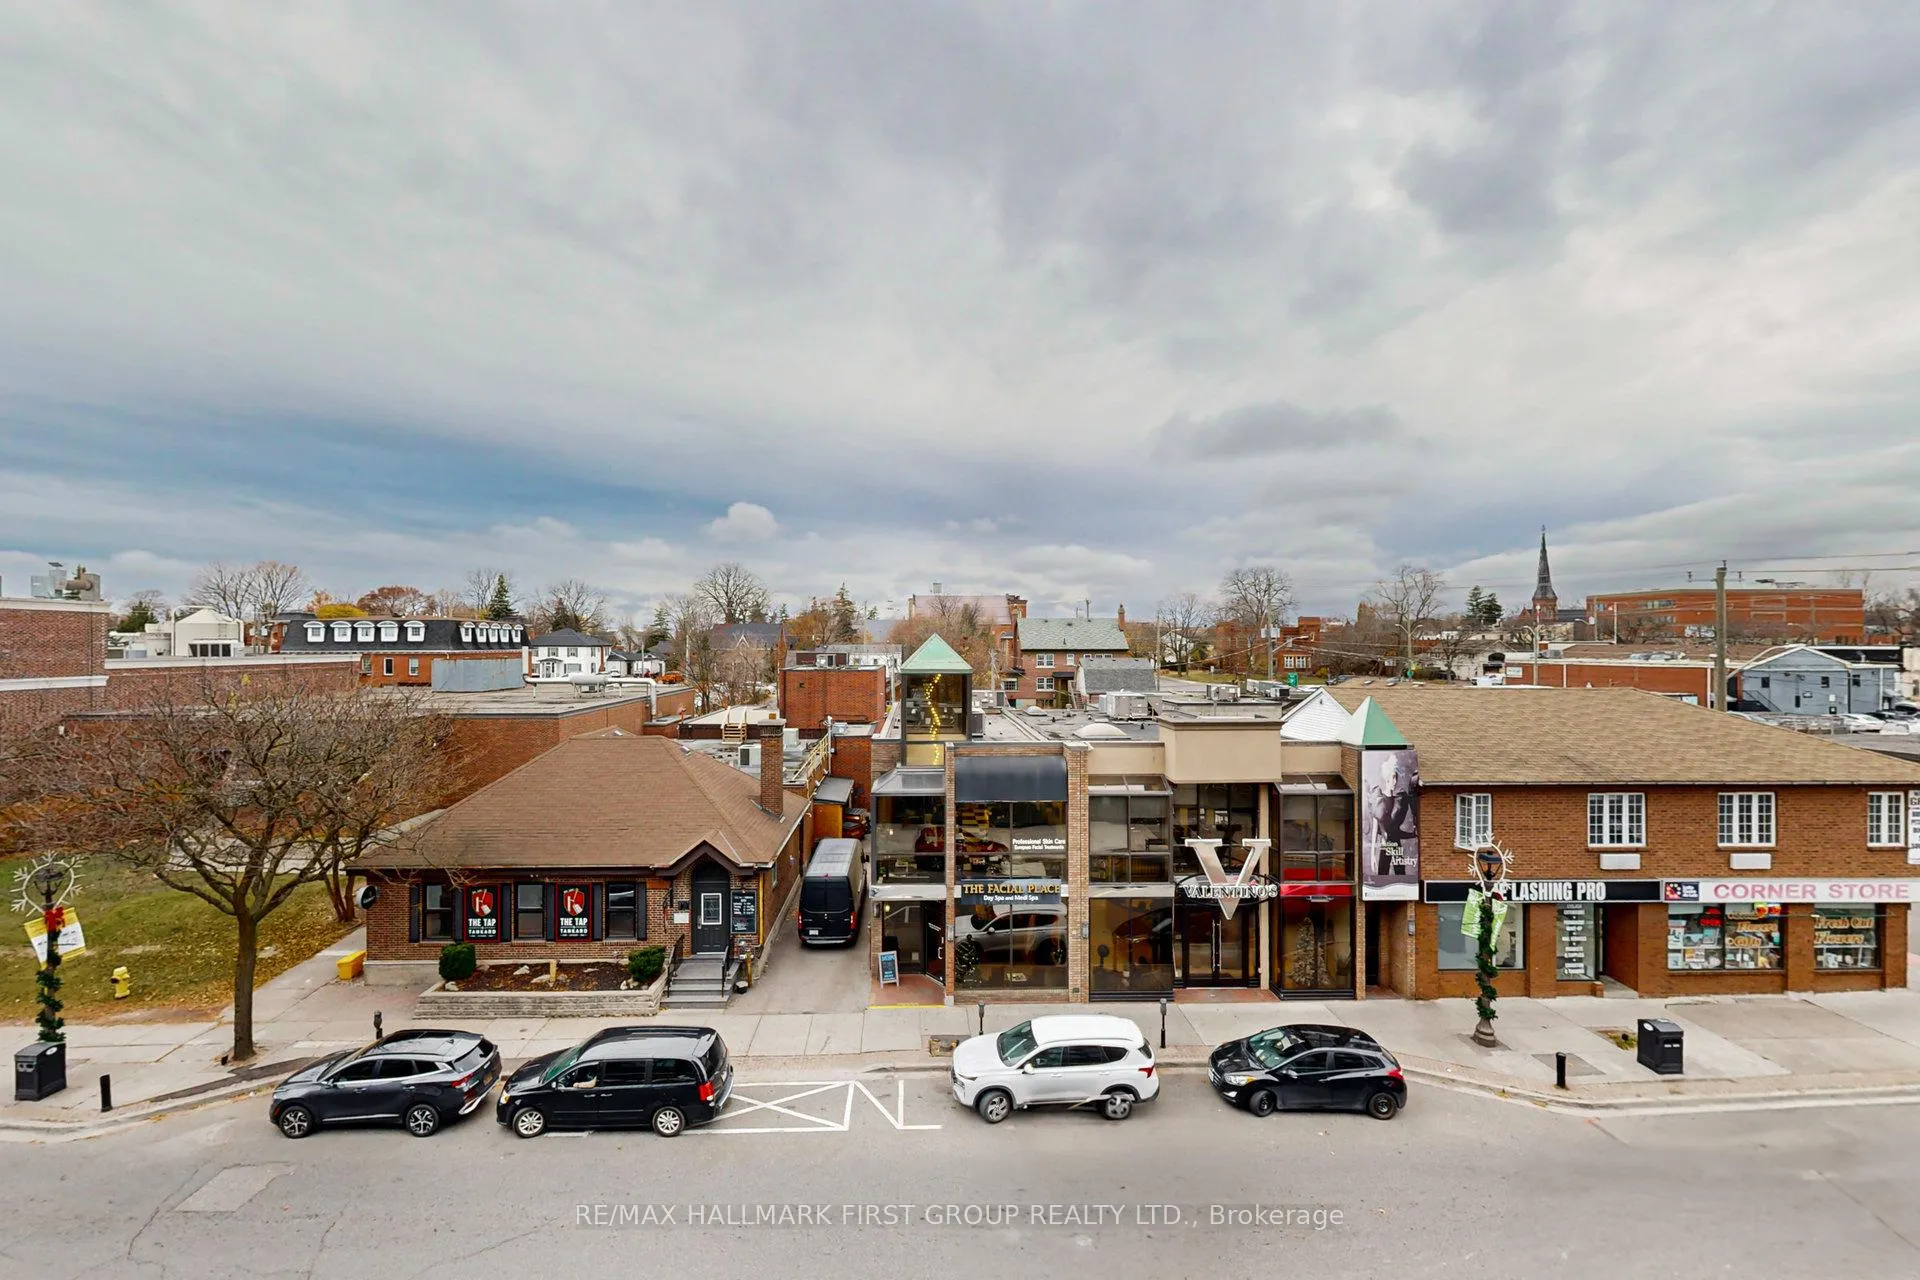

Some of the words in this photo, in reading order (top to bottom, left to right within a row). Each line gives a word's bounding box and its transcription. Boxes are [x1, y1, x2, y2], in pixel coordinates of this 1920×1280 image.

[1385, 846, 1404, 856] Skill
[1390, 855, 1418, 867] Artistry
[1185, 838, 1272, 920] V
[963, 883, 985, 894] THE
[987, 883, 1025, 894] FACIAL
[1028, 883, 1060, 894] PLACE
[1182, 884, 1279, 899] VALENTINO'S
[1511, 882, 1573, 901] LASHING
[1576, 882, 1607, 901] PRO
[1713, 883, 1817, 899] CORNER
[1828, 883, 1909, 899] STORE
[467, 918, 482, 927] THE
[483, 918, 497, 927] TAP
[559, 917, 574, 926] THE
[575, 917, 588, 926] TAP
